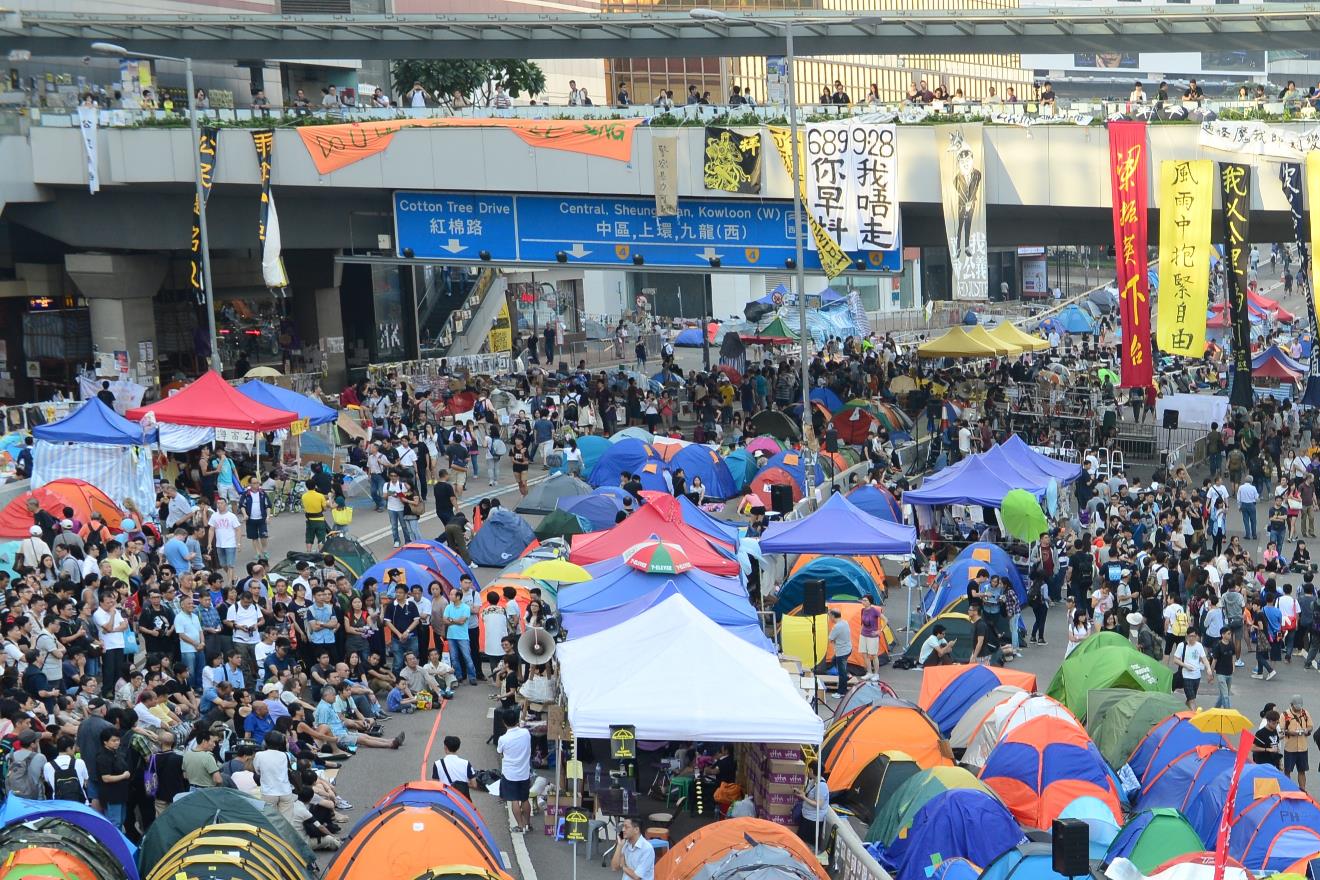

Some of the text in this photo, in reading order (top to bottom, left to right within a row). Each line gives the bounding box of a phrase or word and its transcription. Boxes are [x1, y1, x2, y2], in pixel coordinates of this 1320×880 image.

[807, 128, 849, 156] 689
[400, 200, 511, 215] Cotton Tree Drive
[430, 218, 483, 236] 紅棉路
[560, 202, 609, 216] Central,
[700, 206, 751, 219] Kowloon
[757, 207, 781, 222] (W)
[811, 157, 848, 246] 你早抖
[856, 158, 892, 249] 我唔走
[1116, 143, 1146, 366] 梁振英下台
[1171, 161, 1199, 351] 風雨中抱緊自由
